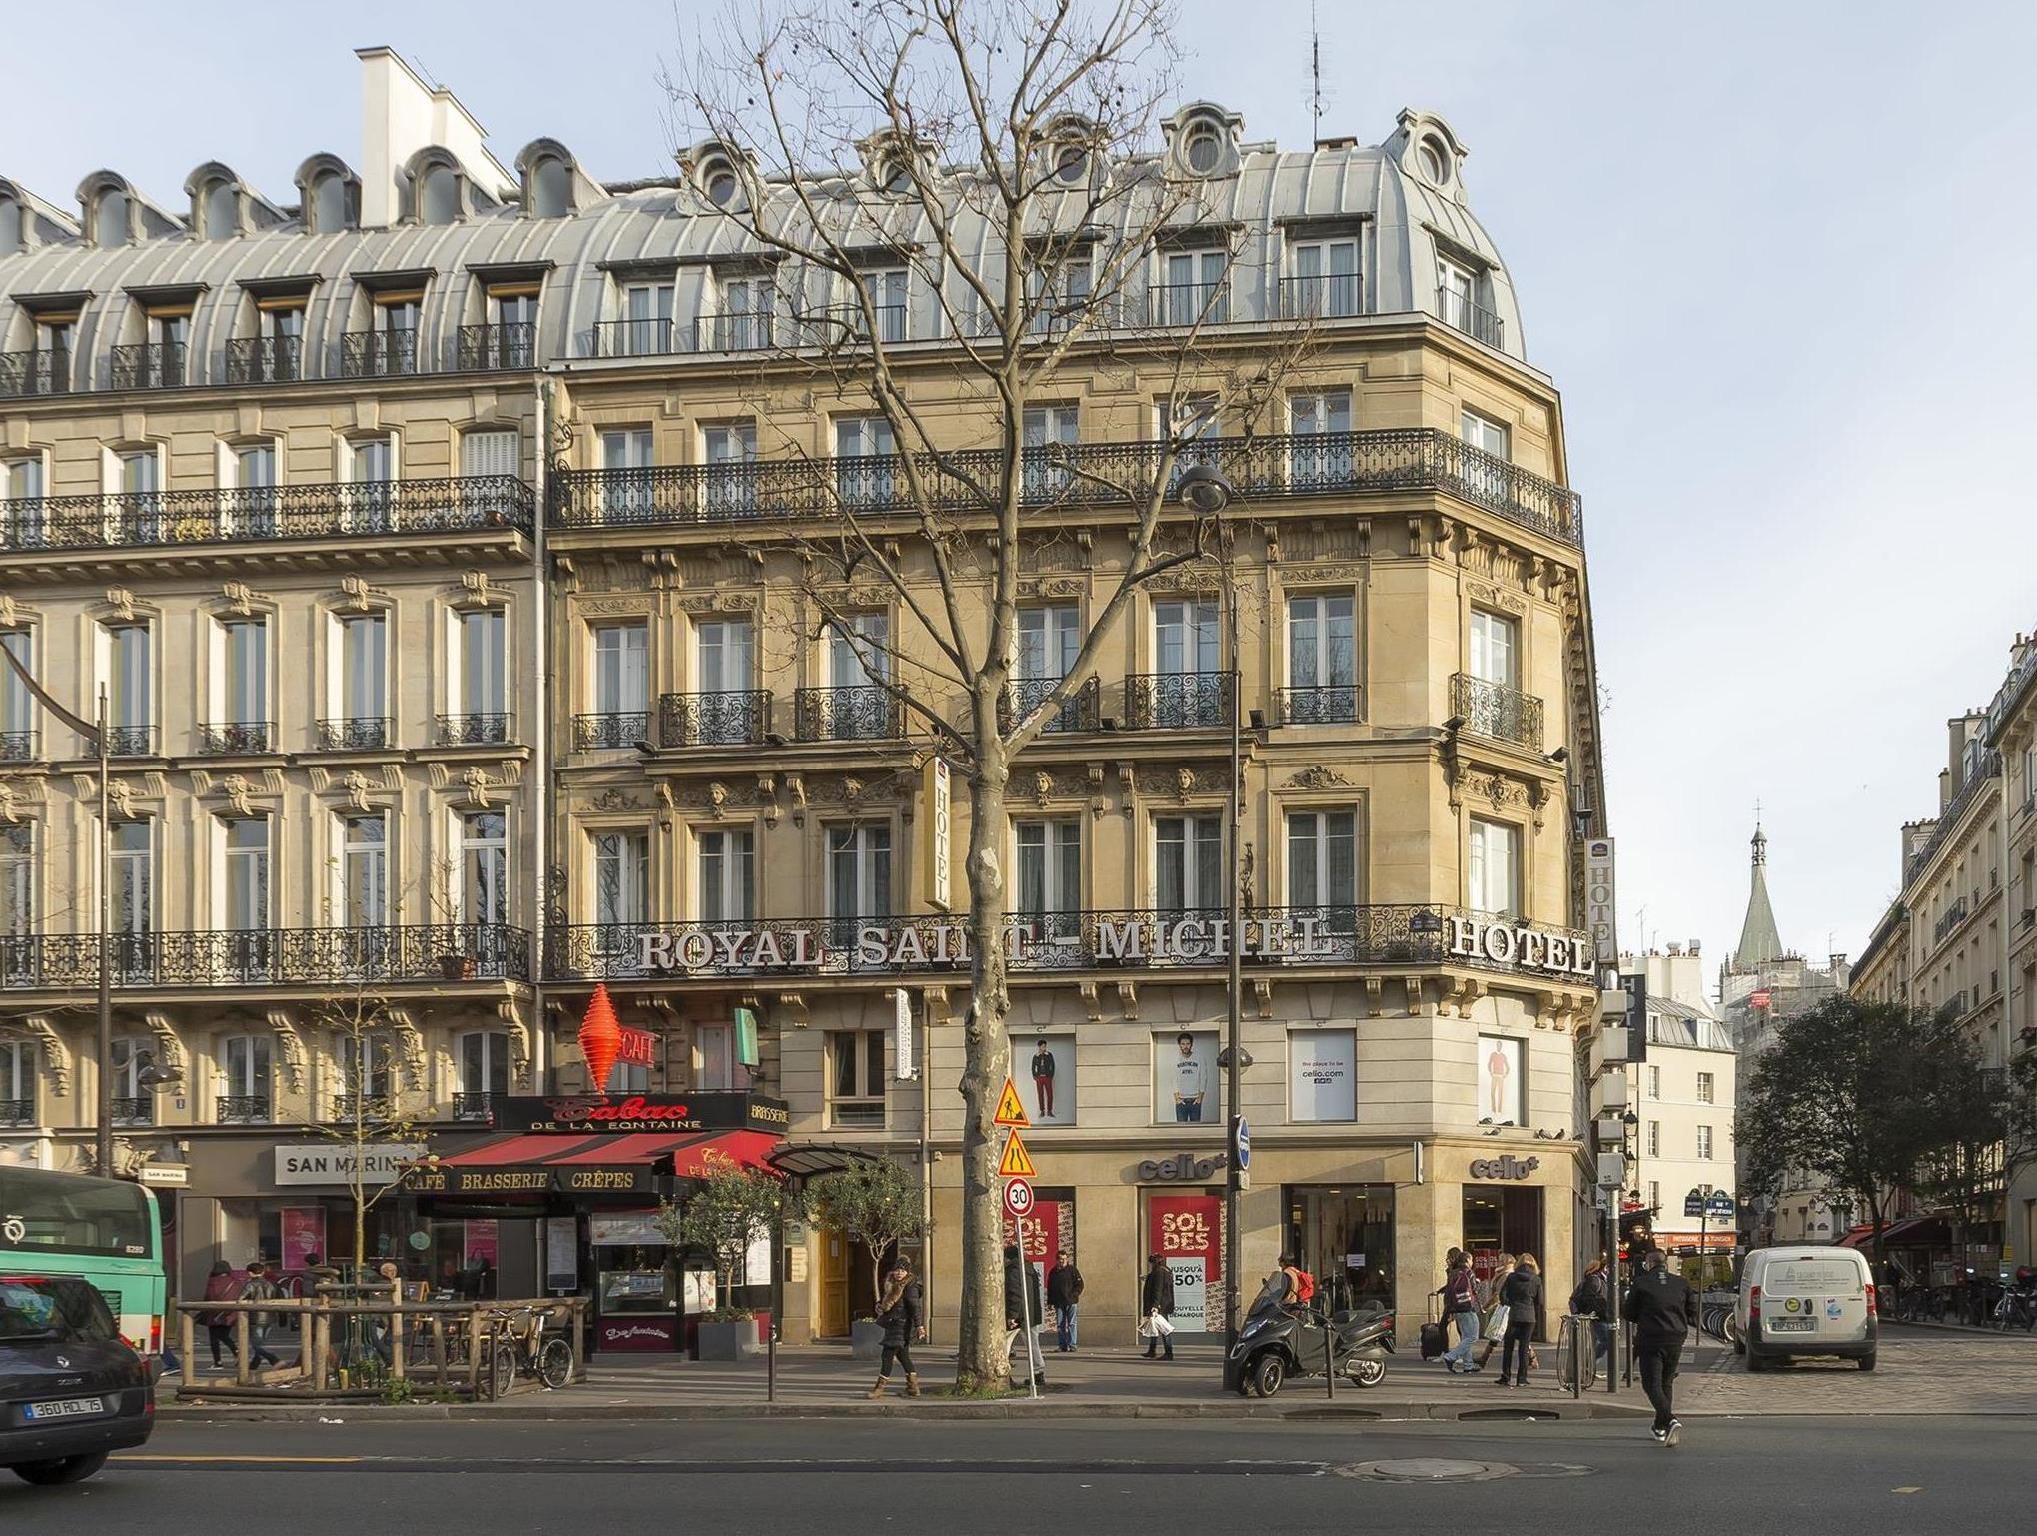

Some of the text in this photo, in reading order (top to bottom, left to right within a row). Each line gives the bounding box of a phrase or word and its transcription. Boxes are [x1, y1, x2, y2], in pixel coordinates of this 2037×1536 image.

[937, 786, 947, 904] HOTEL
[1590, 867, 1611, 961] HOTEL
[638, 929, 827, 970] ROYAL
[857, 922, 1033, 964] SAIT
[1095, 917, 1333, 960] MICHEL
[1450, 915, 1595, 976] HOTEL
[1302, 1069, 1344, 1078] celio.com
[531, 1121, 556, 1130] DE
[569, 1121, 594, 1130] LA
[287, 1157, 327, 1173] SAN
[461, 1172, 548, 1190] BRASSERIE
[571, 1169, 634, 1188] CRÊPES
[1011, 1189, 1027, 1205] 30
[1162, 1213, 1210, 1232] SOL
[1163, 1231, 1209, 1251] DES
[36, 1403, 61, 1417] 360
[86, 1399, 101, 1411] 75
